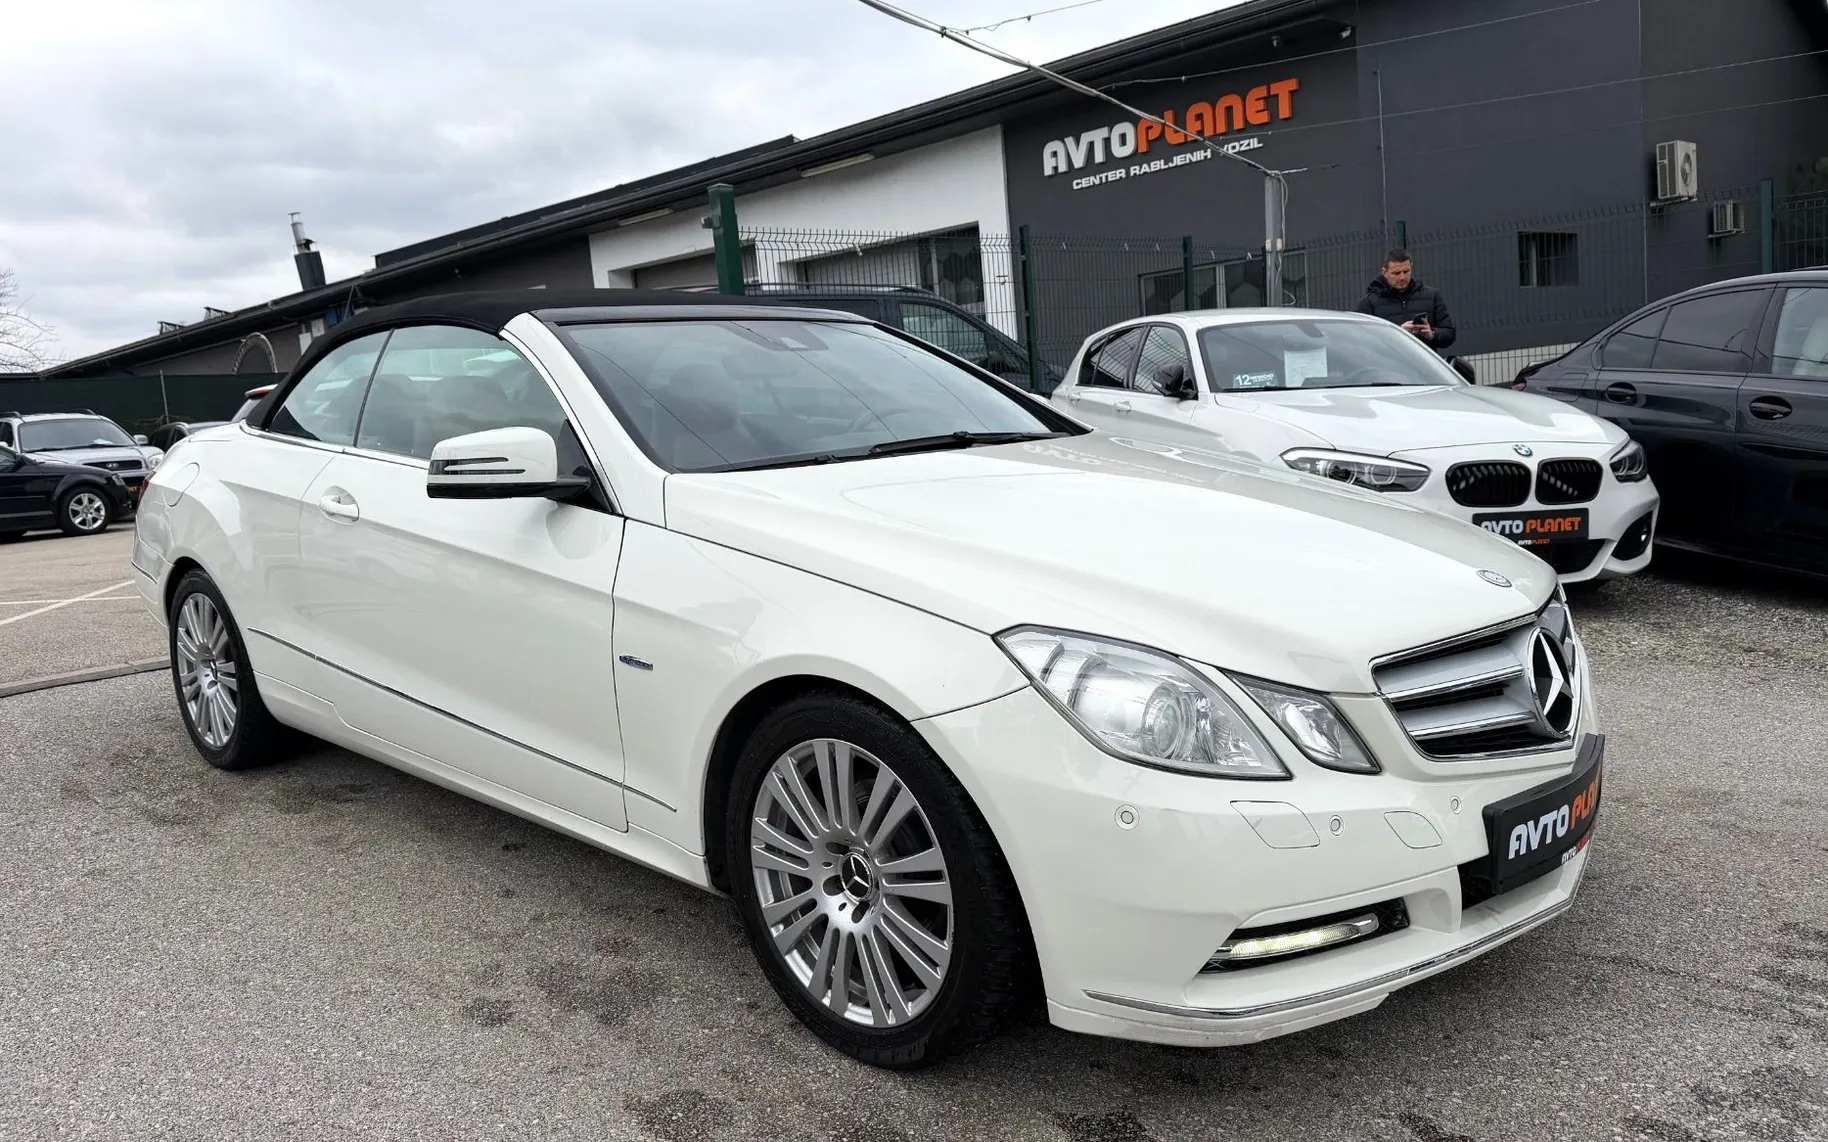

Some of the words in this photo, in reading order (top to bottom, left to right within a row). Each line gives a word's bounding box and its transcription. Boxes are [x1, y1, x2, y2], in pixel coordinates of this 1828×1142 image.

[1072, 169, 1126, 190] CENTER
[1130, 149, 1212, 177] RABLJENIH
[1235, 374, 1252, 386] 12
[1481, 519, 1524, 534] AVTO
[1526, 516, 1582, 533] PLANET
[1508, 803, 1570, 861] AVTO
